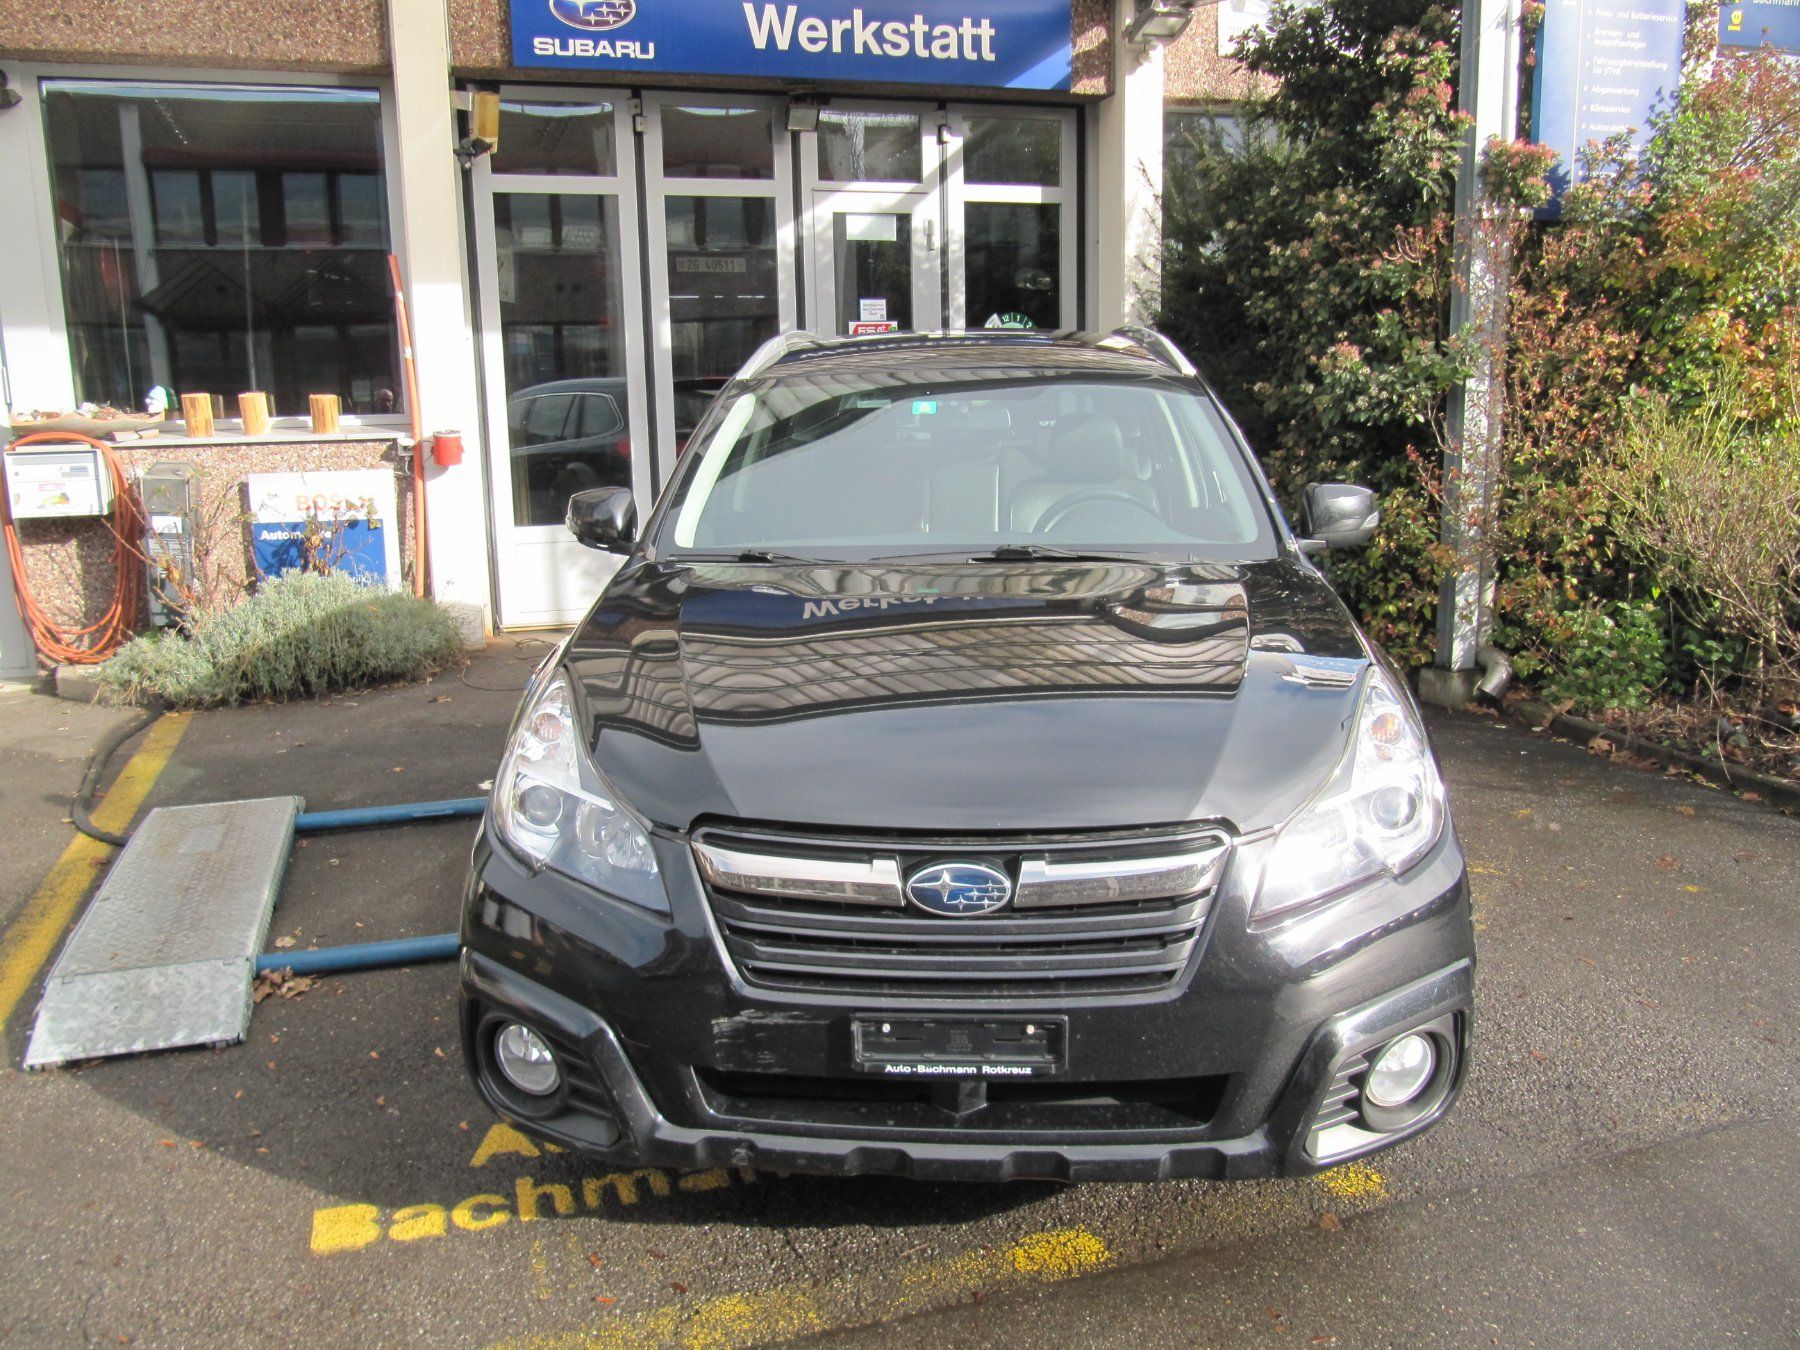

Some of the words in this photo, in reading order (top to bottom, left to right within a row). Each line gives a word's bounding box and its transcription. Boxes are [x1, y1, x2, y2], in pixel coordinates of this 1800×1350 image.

[1631, 11, 1677, 22] Batterieservice
[743, 2, 996, 62] Werkstatt
[1626, 30, 1640, 39] und
[533, 37, 655, 60] SUBARU
[1002, 314, 1010, 323] 12
[982, 1065, 1032, 1075] Rotkreuz
[310, 1168, 757, 1256] Bachma
